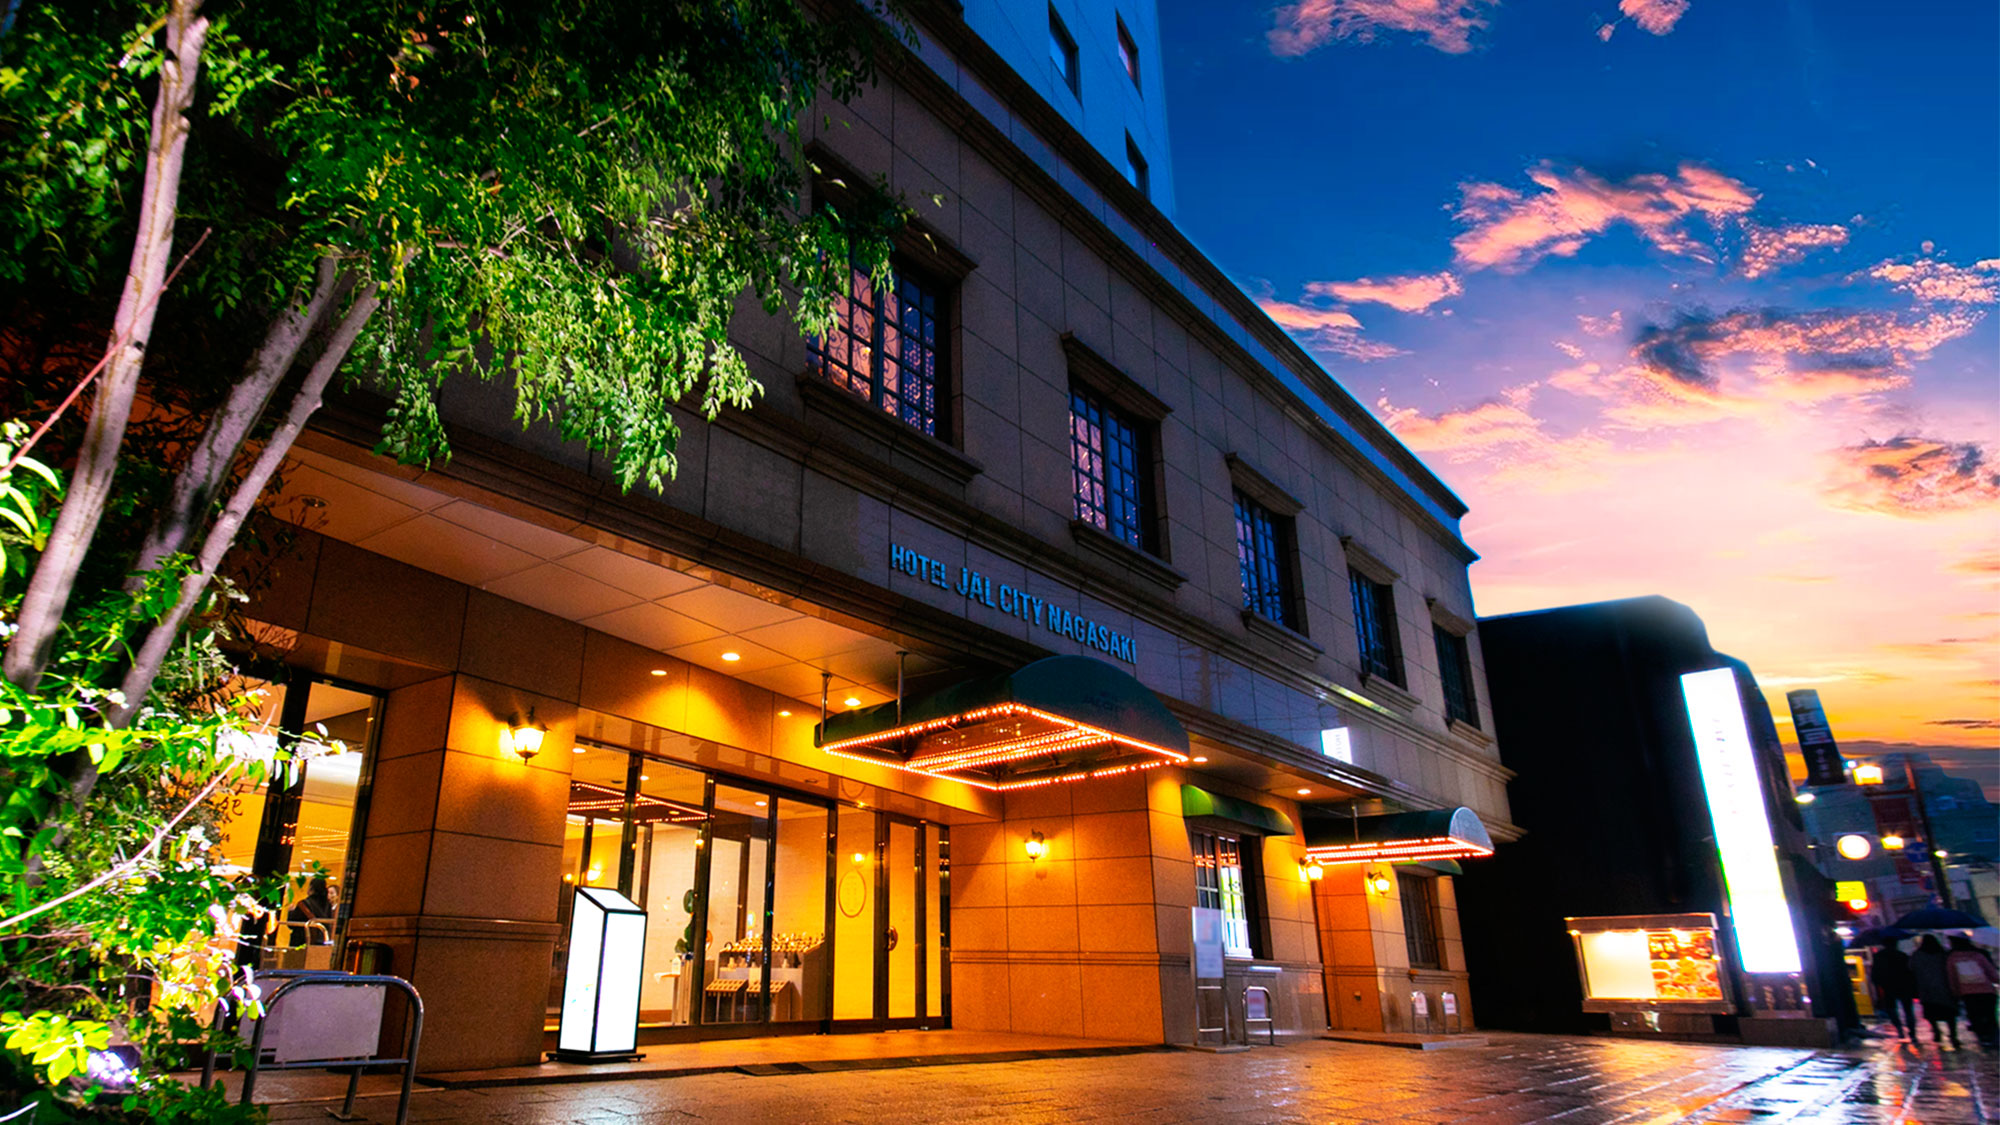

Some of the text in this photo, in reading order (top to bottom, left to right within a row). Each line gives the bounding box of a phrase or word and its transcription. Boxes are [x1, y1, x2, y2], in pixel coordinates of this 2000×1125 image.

[891, 543, 1137, 665] HOTEL JAL CITY NAGASAKI
